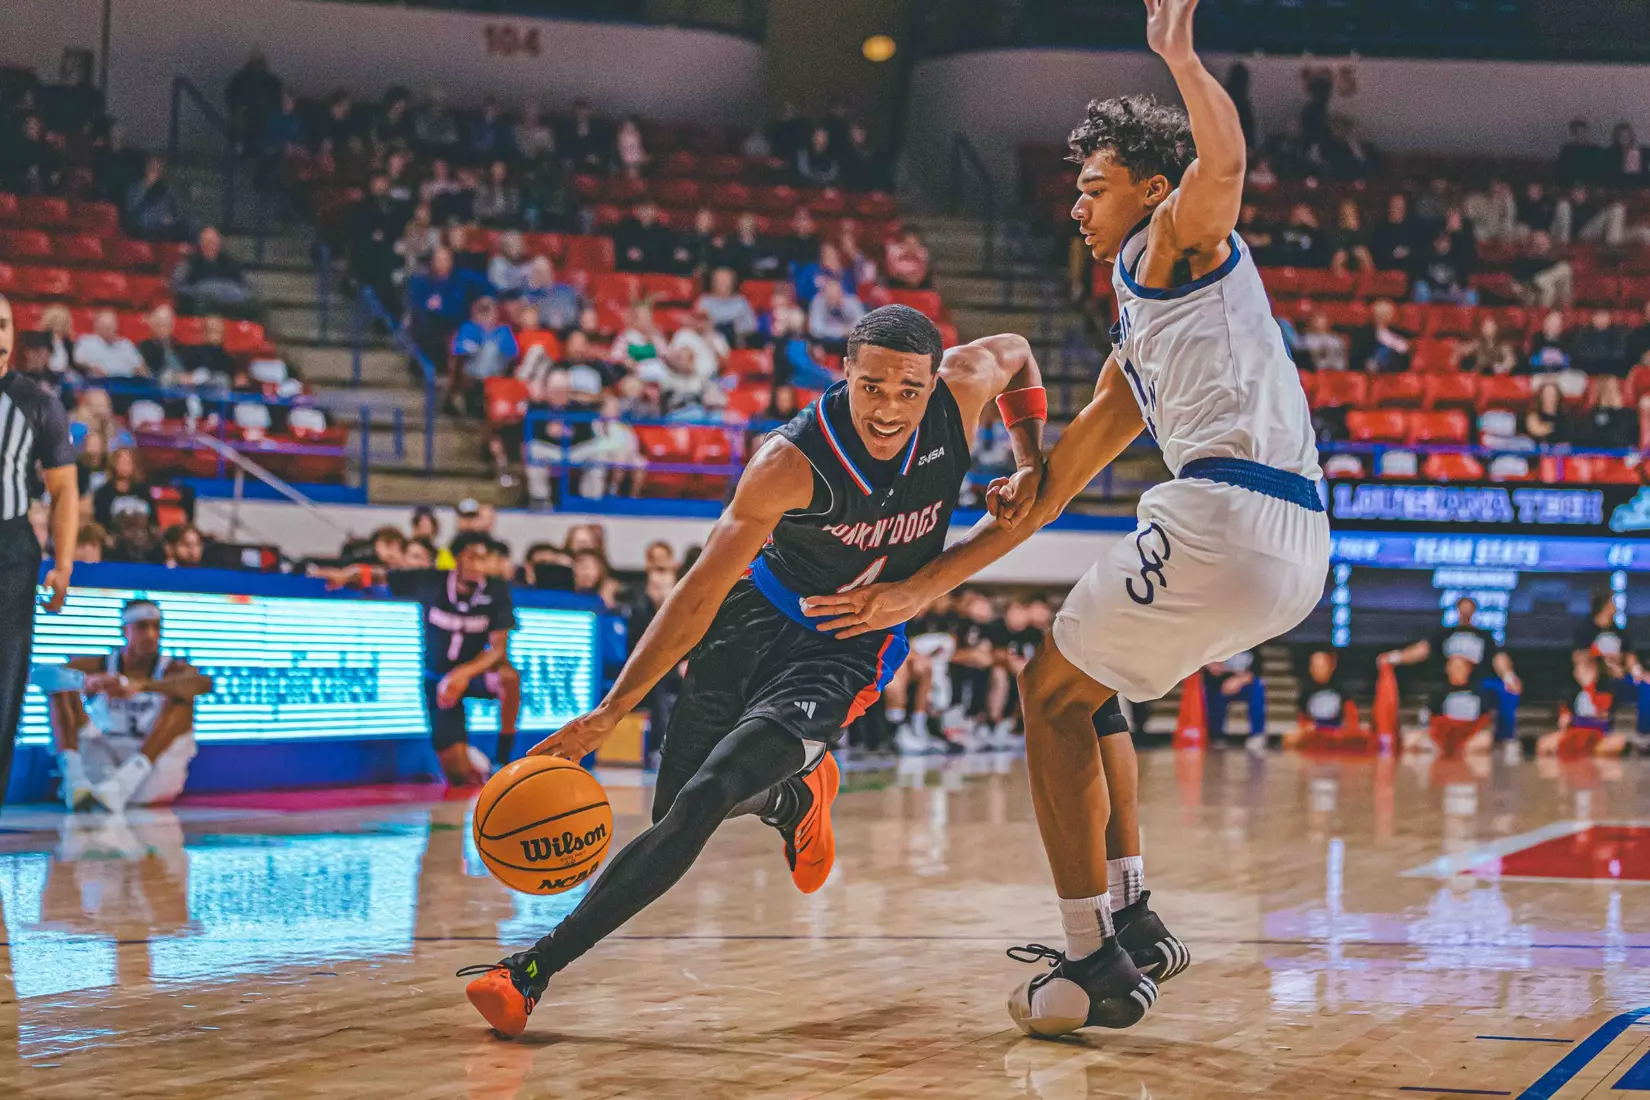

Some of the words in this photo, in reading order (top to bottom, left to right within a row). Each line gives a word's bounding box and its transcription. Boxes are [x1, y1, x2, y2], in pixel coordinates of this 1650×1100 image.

[484, 23, 540, 57] 104
[520, 823, 606, 862] Wilson
[537, 861, 599, 890] NCAA
